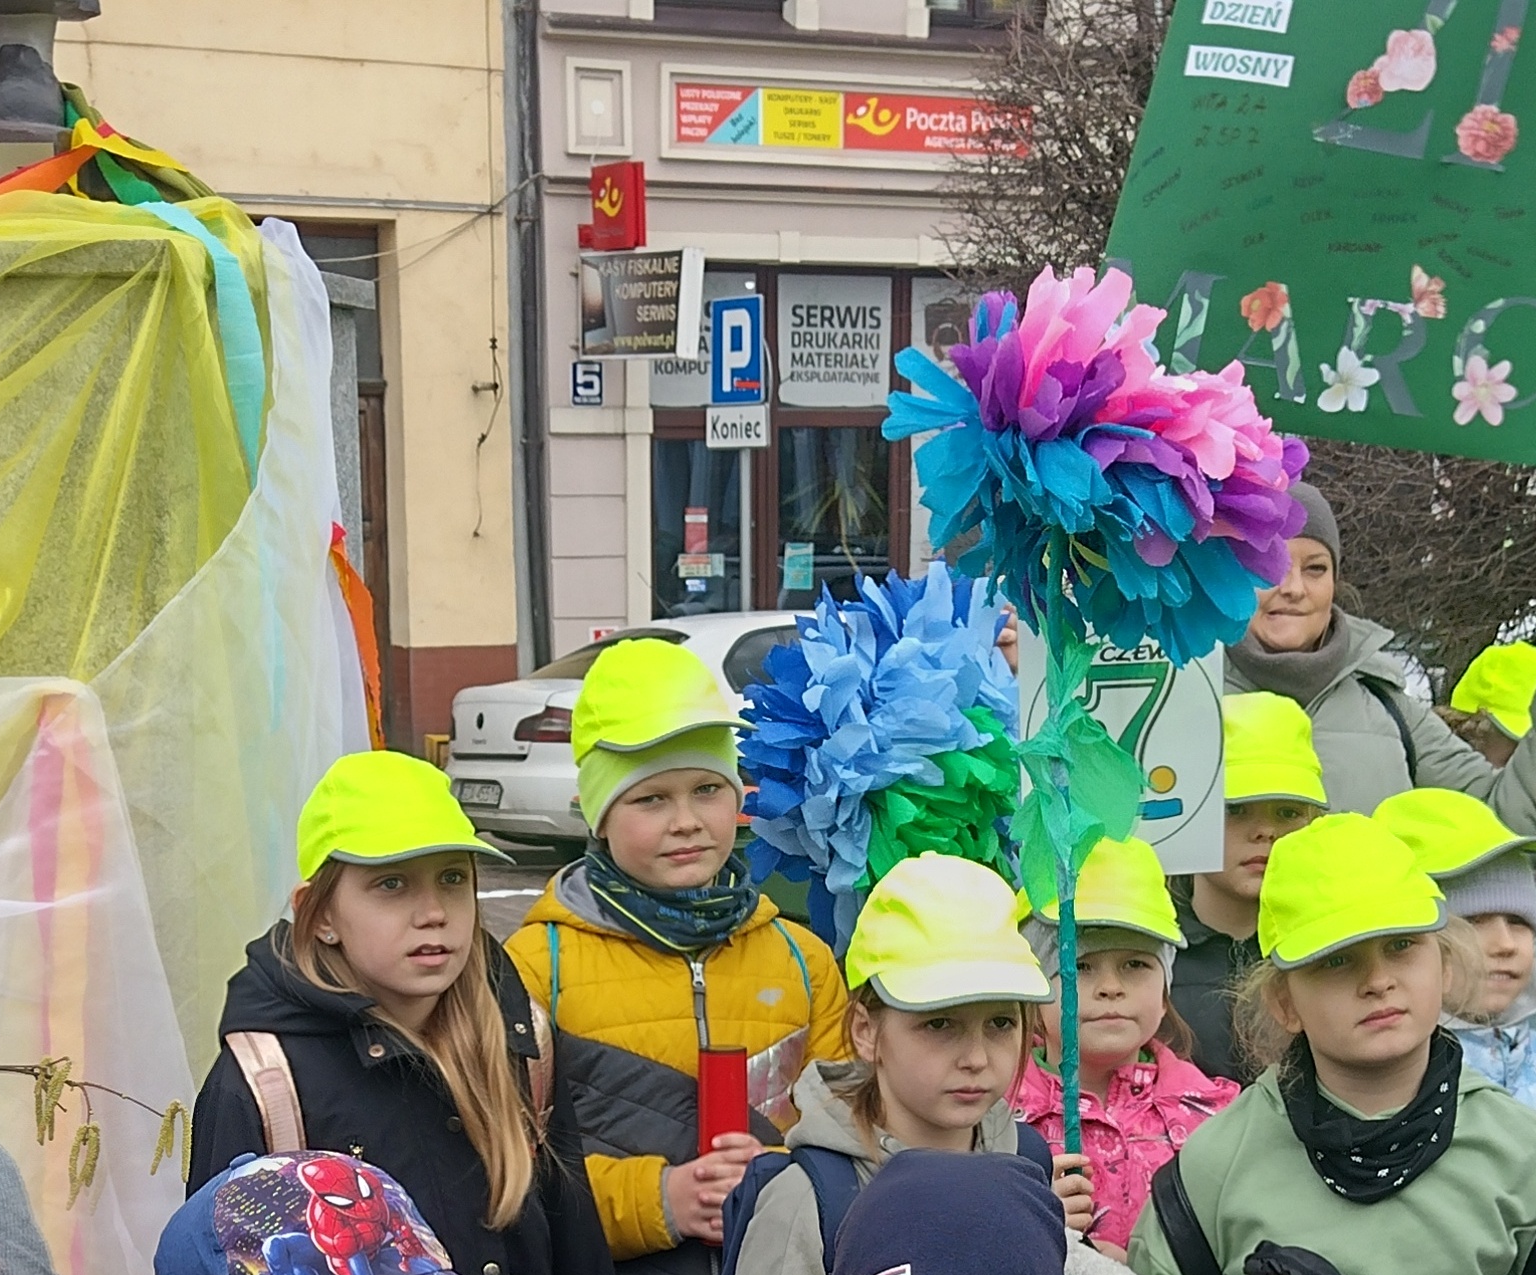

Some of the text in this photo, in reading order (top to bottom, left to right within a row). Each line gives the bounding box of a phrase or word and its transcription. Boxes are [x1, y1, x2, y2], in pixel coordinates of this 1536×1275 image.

[1208, 0, 1283, 28] DZIEŃ
[1194, 51, 1289, 79] WIOSNY
[905, 107, 967, 133] Poczta
[627, 257, 679, 275] FISKALNE
[616, 281, 679, 299] KOMPUTERY
[636, 304, 676, 322] SERWIS
[791, 304, 881, 329] SERWIS
[722, 308, 752, 392] P
[791, 331, 880, 350] DRUKARKI
[654, 360, 710, 375] KOMPU
[790, 352, 879, 369] MATERIAŁY
[575, 363, 601, 396] 5
[790, 370, 880, 386] EKSPLOATACYJNE
[711, 415, 761, 440] Koniec
[1098, 643, 1167, 663] CZEW
